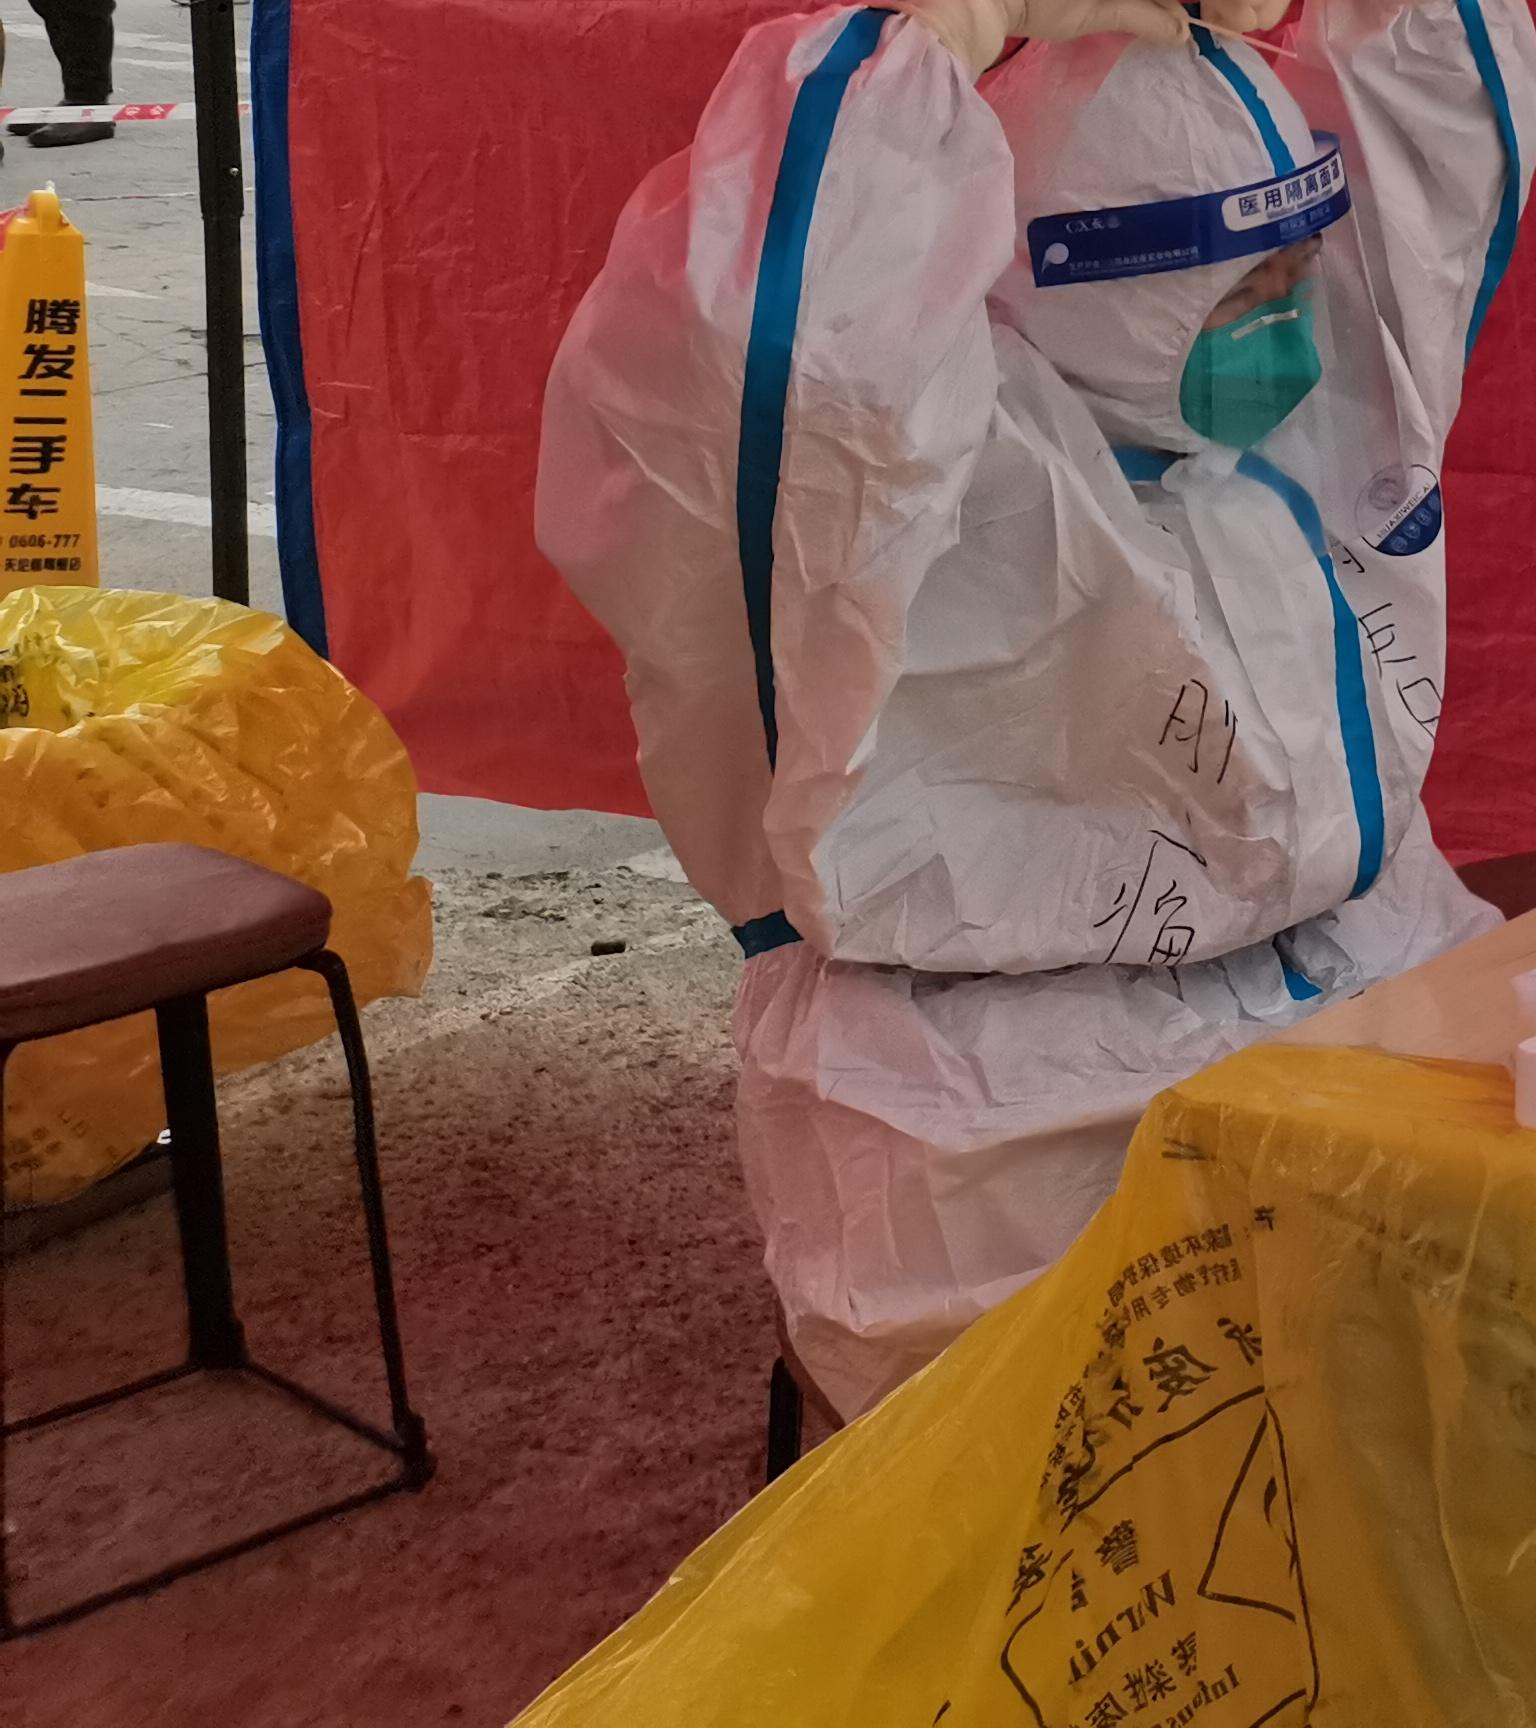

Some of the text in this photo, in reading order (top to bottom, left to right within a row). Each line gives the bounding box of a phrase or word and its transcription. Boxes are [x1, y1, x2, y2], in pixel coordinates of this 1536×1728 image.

[4, 298, 80, 520] 腾发二手车
